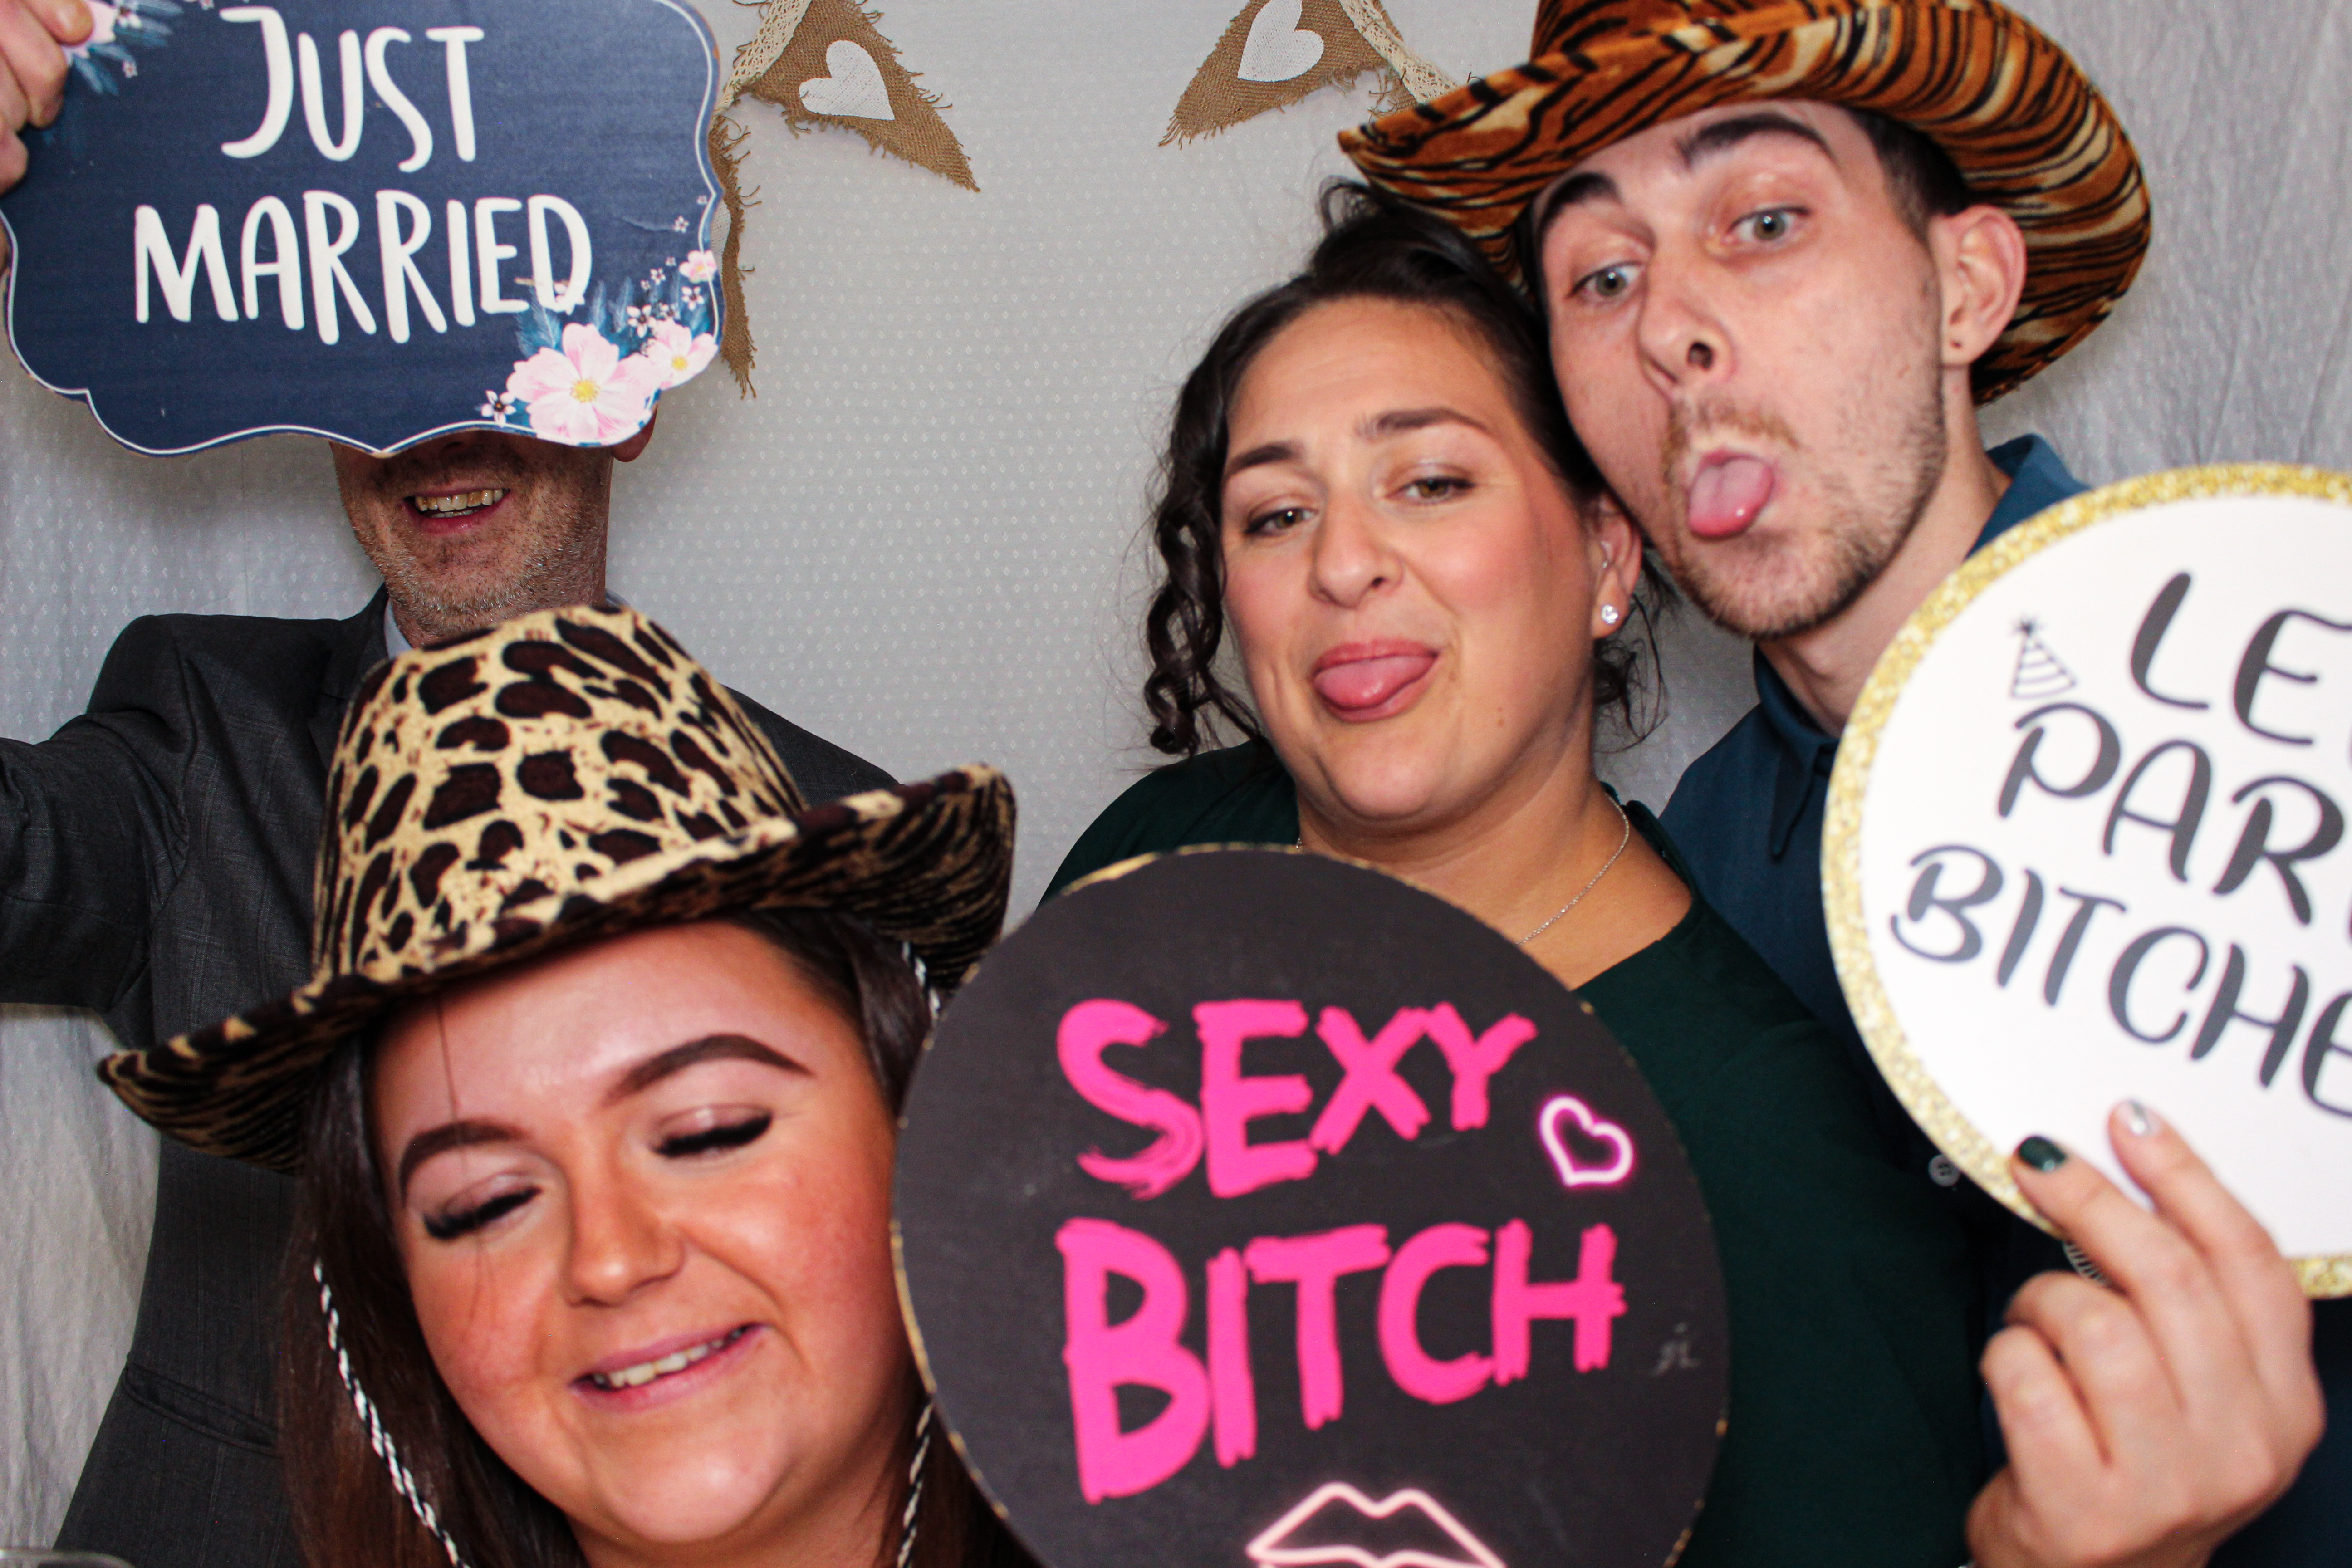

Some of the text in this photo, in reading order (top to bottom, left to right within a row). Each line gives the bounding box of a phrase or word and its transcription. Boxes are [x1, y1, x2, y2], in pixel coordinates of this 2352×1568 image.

[220, 6, 485, 173] JUST
[134, 190, 593, 346] MARRIED
[2129, 571, 2352, 749] LE
[1997, 701, 2352, 926] PAR
[1055, 998, 1538, 1200] SEXY
[1054, 1218, 1628, 1505] BITCH
